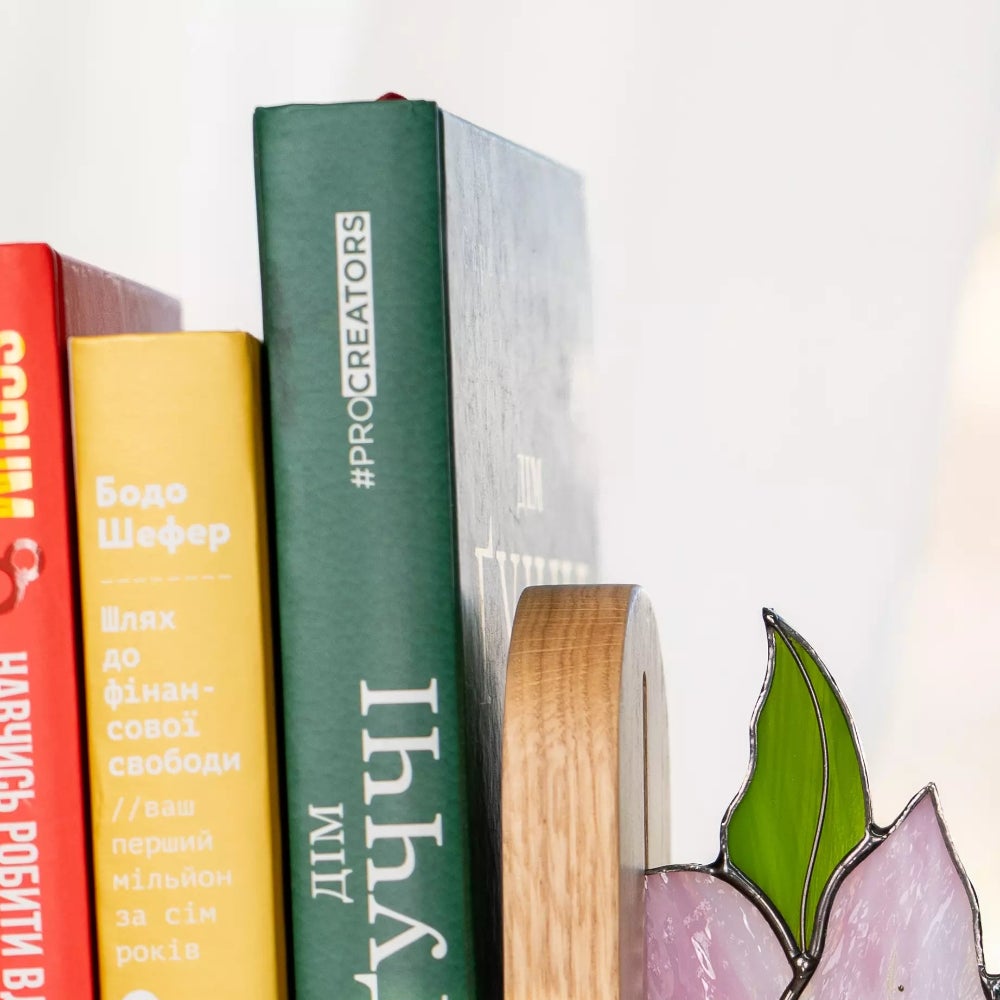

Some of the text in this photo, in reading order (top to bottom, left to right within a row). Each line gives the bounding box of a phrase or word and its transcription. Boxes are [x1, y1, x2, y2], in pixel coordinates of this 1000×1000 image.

[340, 213, 376, 489] #PROCREATORS
[95, 475, 188, 509] Бодо
[98, 515, 232, 555] Шефер
[100, 605, 176, 633] Шлях
[102, 646, 141, 672] до
[104, 676, 215, 711] фінан-
[0, 652, 35, 812] НАВЧИСЬ
[106, 710, 201, 740] сової
[108, 747, 242, 777] свободи
[111, 831, 214, 858] перший
[308, 803, 354, 903] ДІМ
[0, 821, 43, 956] РОБИТИ
[112, 867, 233, 890] мільйон
[115, 902, 217, 927] за сім
[115, 939, 201, 967] років
